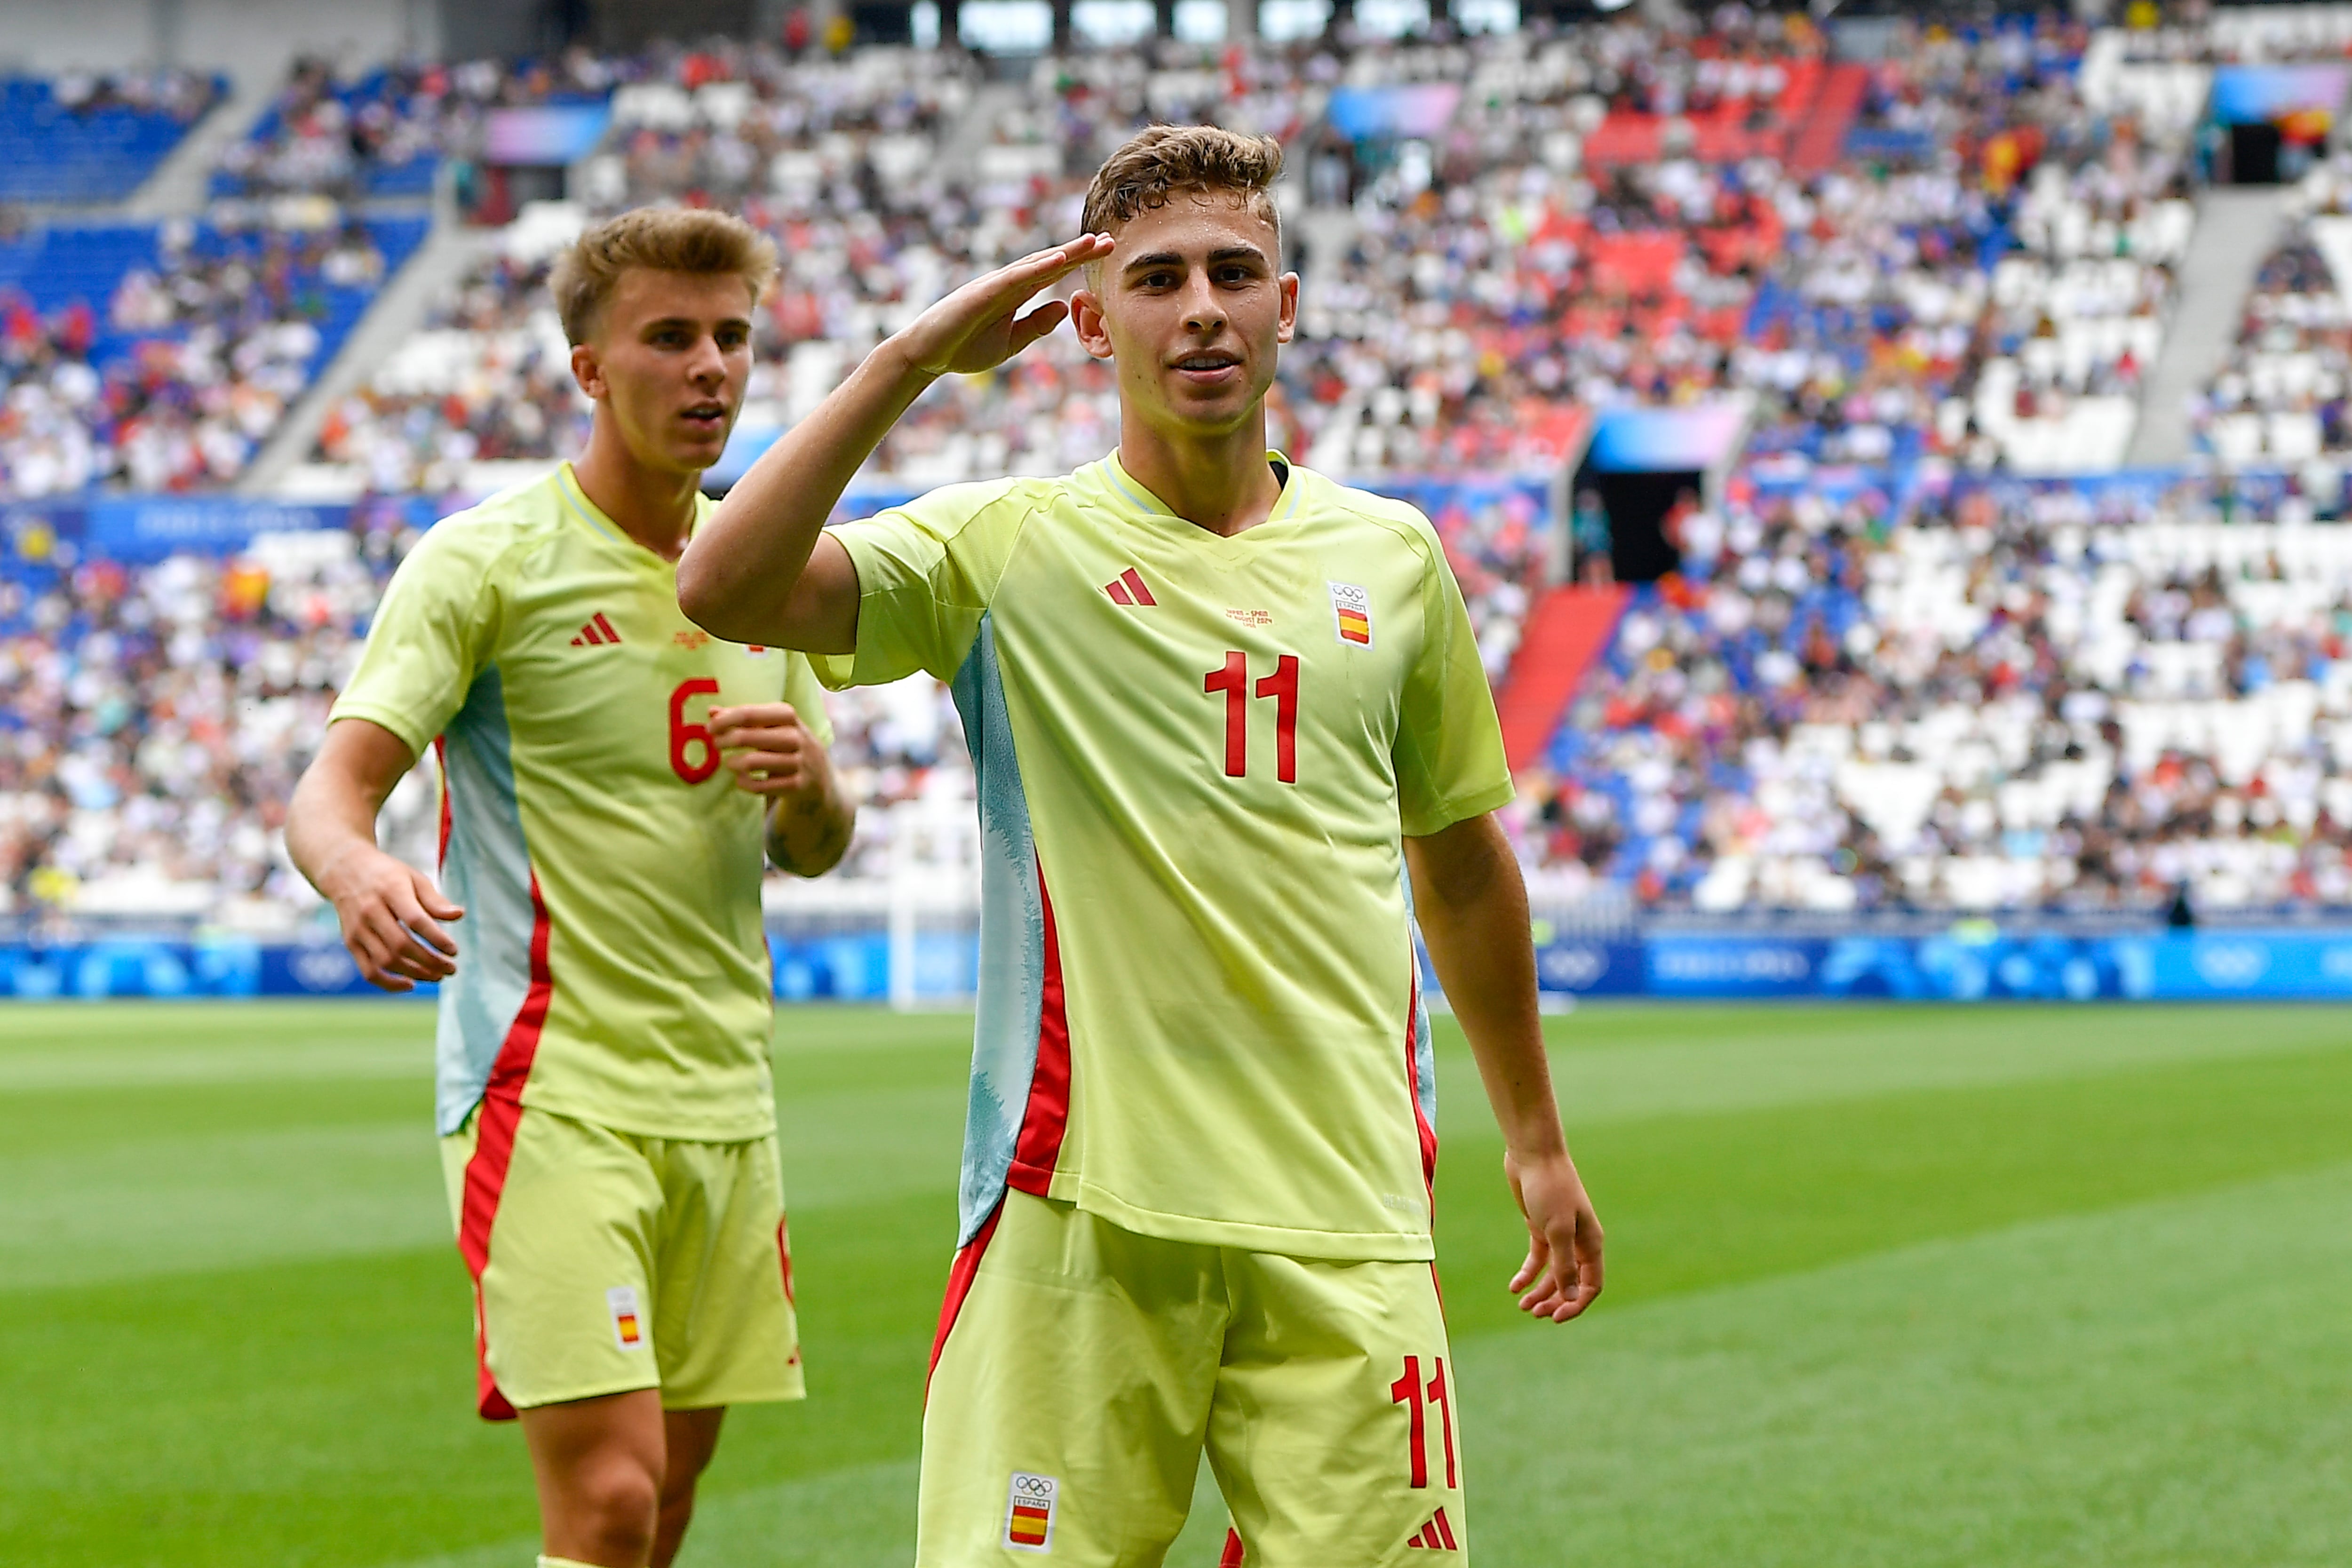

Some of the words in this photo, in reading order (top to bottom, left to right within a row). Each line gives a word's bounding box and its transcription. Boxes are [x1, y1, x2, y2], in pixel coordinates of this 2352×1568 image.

[669, 678, 720, 785] 6
[1204, 650, 1299, 784] 11
[1391, 1355, 1457, 1489] 11
